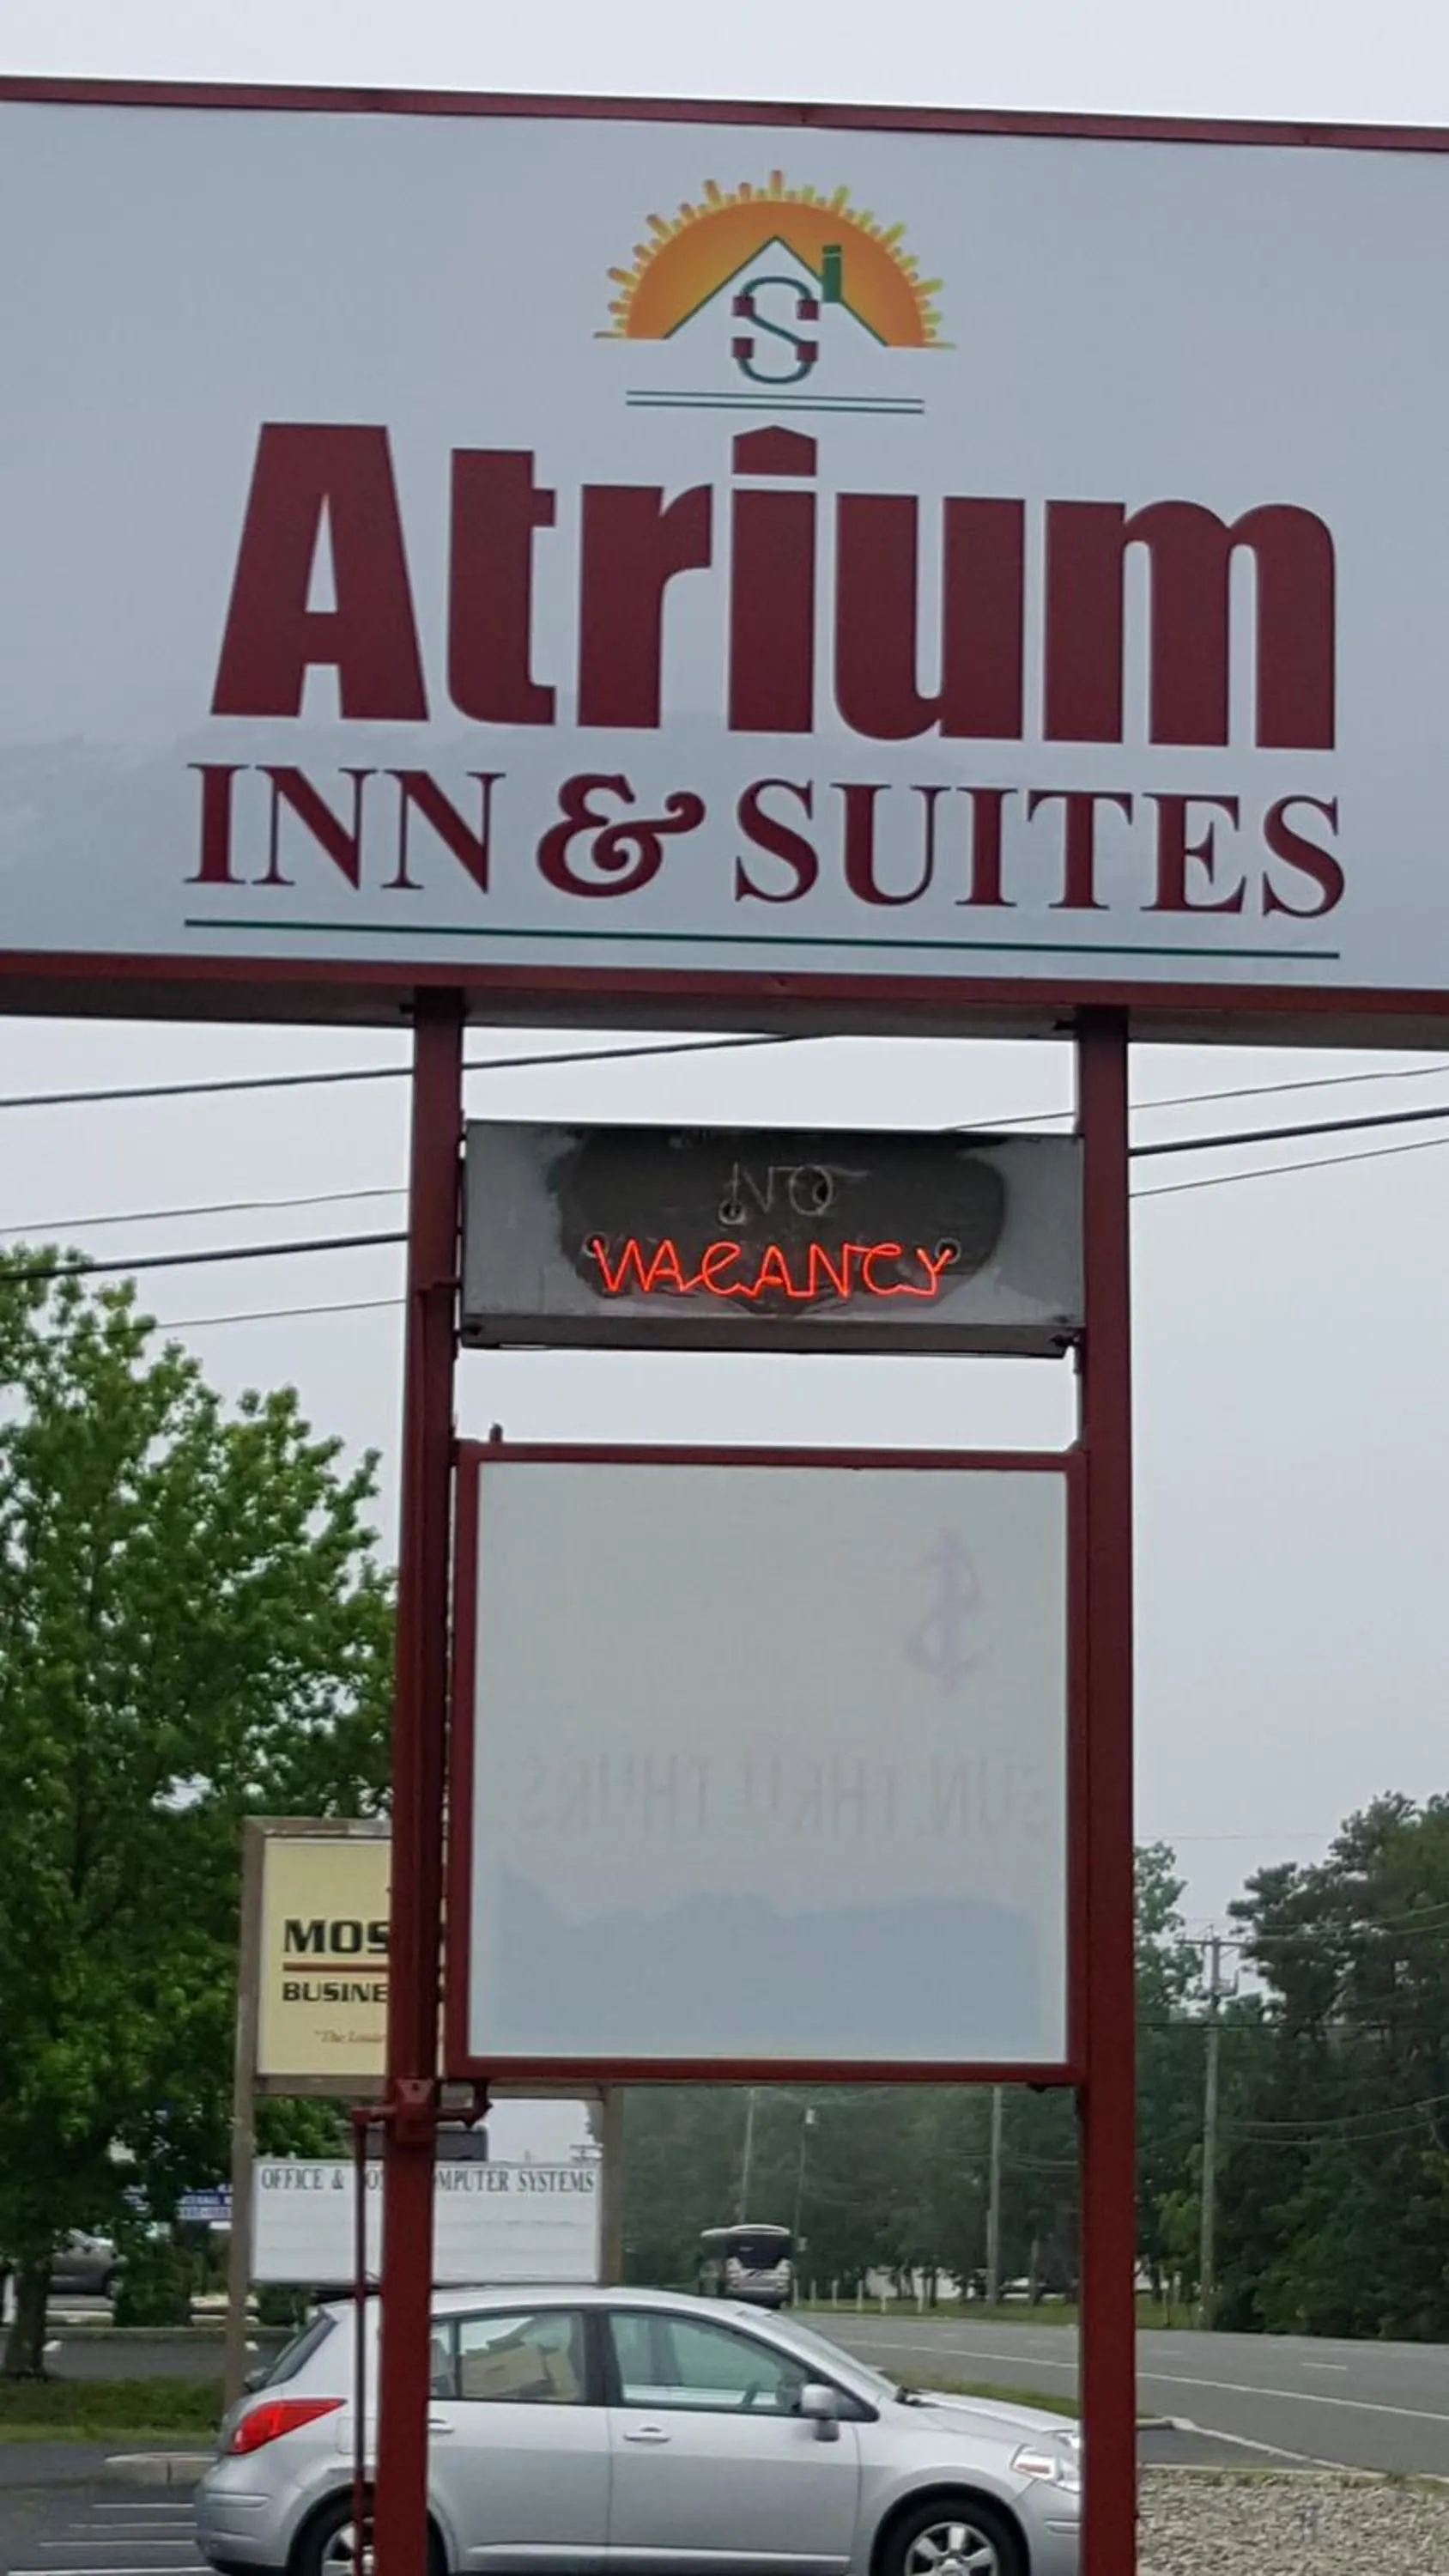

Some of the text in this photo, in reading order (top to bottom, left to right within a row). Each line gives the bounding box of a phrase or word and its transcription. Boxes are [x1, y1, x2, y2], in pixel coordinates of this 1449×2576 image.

[209, 422, 1337, 751] Atrium
[185, 763, 1346, 919] INN & SUITES
[733, 1163, 834, 1216] NO
[591, 1237, 954, 1298] VACANCY
[282, 1981, 388, 2002] BUSINE
[262, 2168, 324, 2190] OFFICE
[331, 2168, 344, 2190] &
[433, 2170, 509, 2192] MPUTER
[517, 2170, 594, 2193] SYSTEMS
